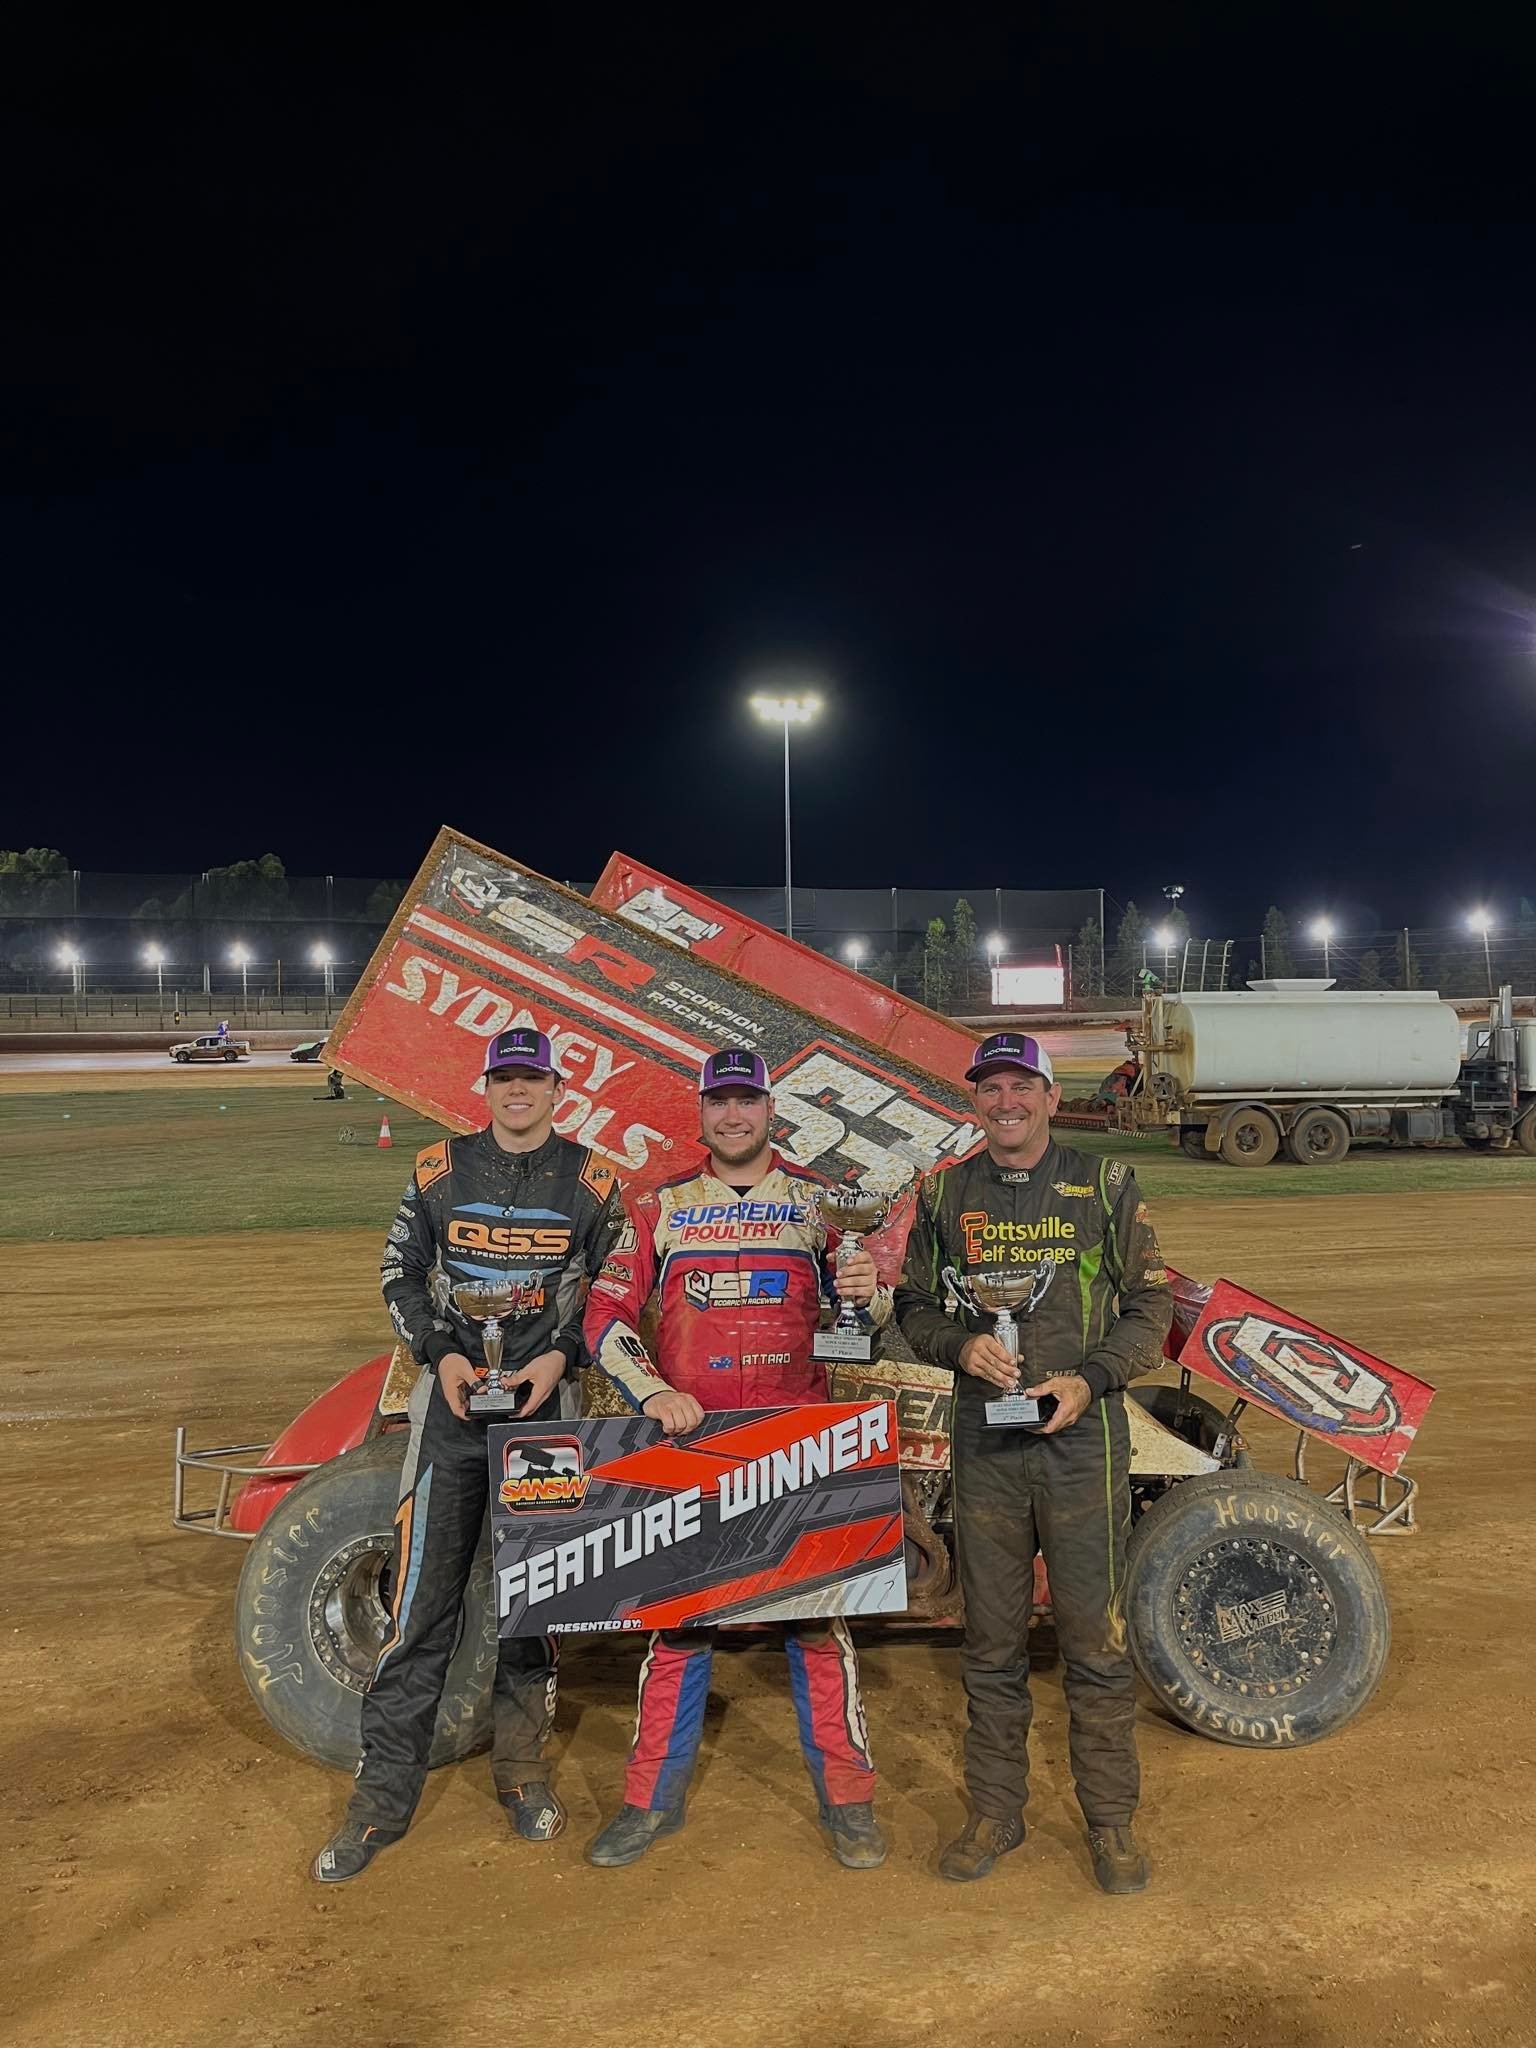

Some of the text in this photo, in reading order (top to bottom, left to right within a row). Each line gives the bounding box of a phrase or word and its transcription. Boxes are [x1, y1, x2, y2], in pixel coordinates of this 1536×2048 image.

[647, 991, 757, 1050] RACEWEAR
[665, 981, 765, 1034] SCORPION
[385, 956, 636, 1092] SYDEY
[500, 1046, 535, 1054] HOOSIER
[984, 1047, 1020, 1057] HOOSIER
[716, 1066, 751, 1074] HOOSIER
[668, 1200, 808, 1230] SUPREME
[960, 1211, 1076, 1241] Pottsville
[683, 1222, 782, 1241] POULTRY
[471, 1250, 530, 1260] SPEEDWAY
[1010, 1246, 1076, 1264] Storage
[741, 1353, 790, 1365] ATTARD
[499, 1475, 592, 1503] SANSW
[498, 1402, 890, 1618] FEATURE WINNER
[1214, 1495, 1346, 1559] Hoosier
[547, 1619, 642, 1634] PRESENTED BY:
[1163, 1681, 1296, 1744] Hoosier
